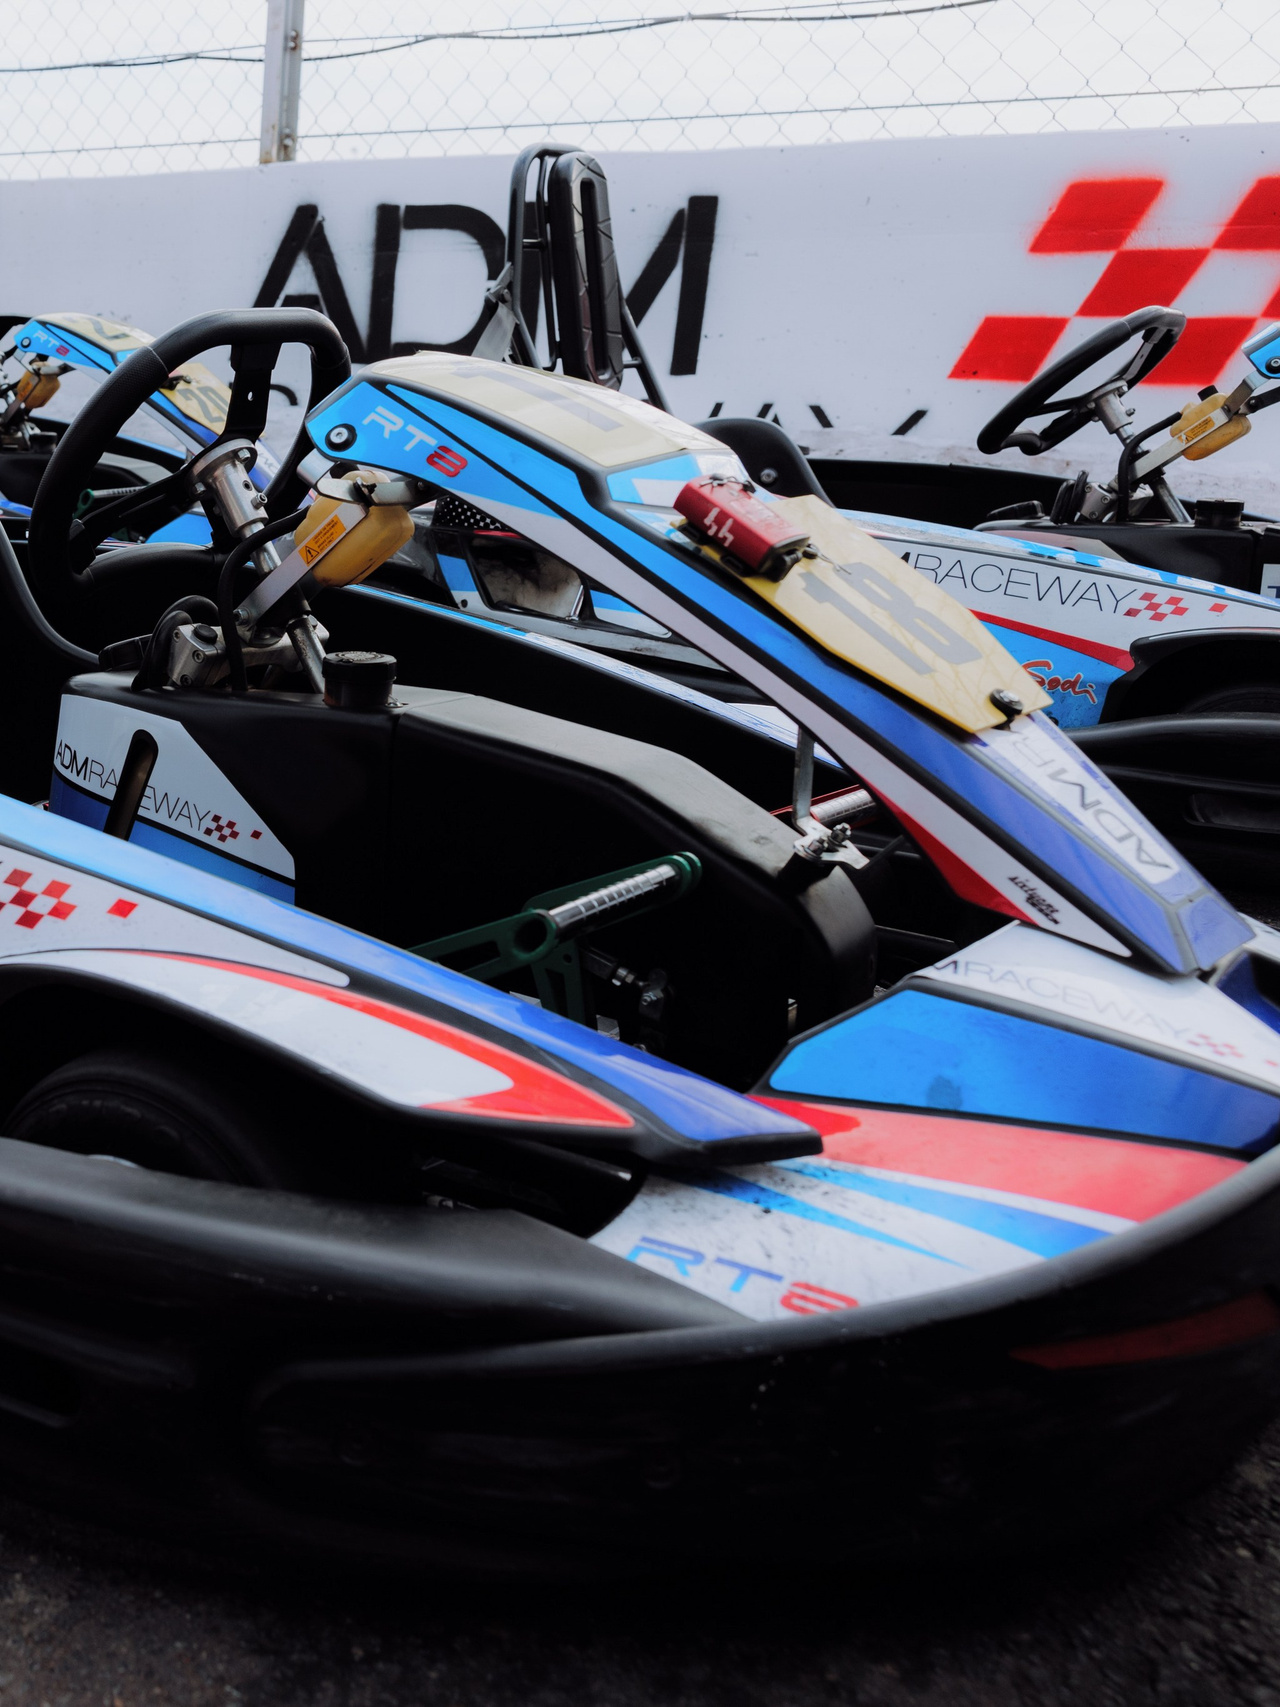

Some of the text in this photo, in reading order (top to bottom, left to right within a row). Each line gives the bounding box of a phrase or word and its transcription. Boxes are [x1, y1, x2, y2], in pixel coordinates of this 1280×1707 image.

[362, 406, 468, 478] RT8
[799, 561, 982, 676] 18
[1022, 660, 1098, 704] Sodi
[56, 739, 211, 831] ADMRAEWAY
[625, 1236, 860, 1315] RT8
